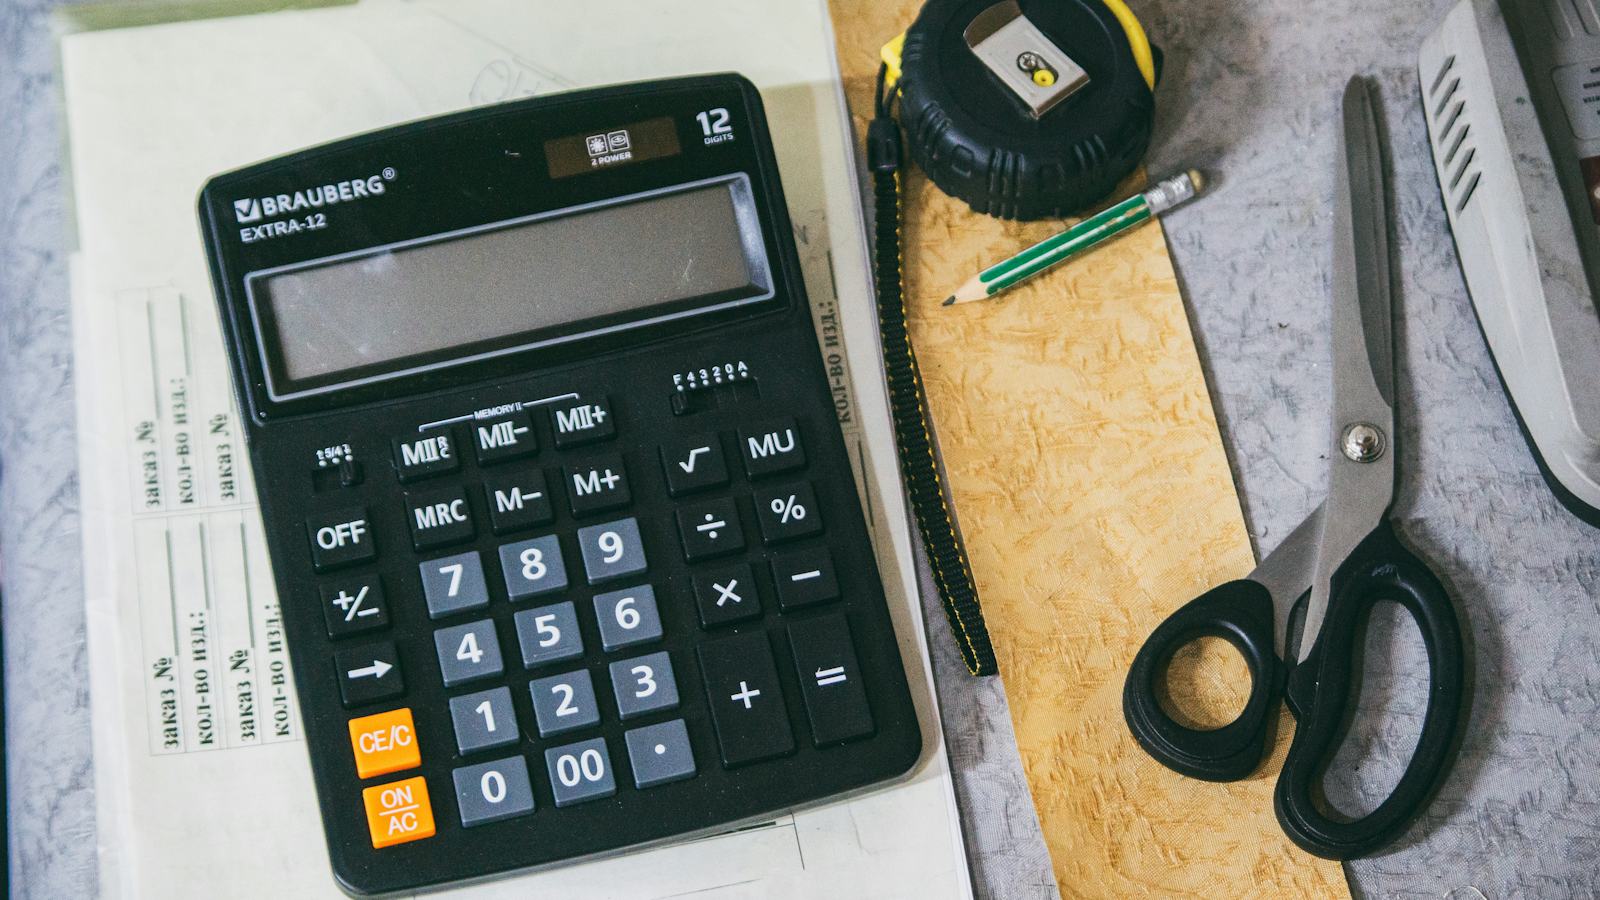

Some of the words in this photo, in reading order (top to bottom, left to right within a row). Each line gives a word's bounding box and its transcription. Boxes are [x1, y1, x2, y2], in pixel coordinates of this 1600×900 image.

[695, 107, 733, 136] 12
[703, 132, 734, 145] DIGITS
[591, 157, 598, 166] 2
[598, 151, 632, 165] POWER
[240, 213, 326, 243] EXTRA-12
[673, 374, 681, 385] F
[687, 371, 695, 381] 4
[699, 368, 708, 379] 3
[712, 366, 720, 377] 2
[738, 360, 748, 372] A
[208, 413, 230, 437] №
[473, 405, 513, 420] MEMORY
[135, 420, 155, 444] №
[748, 429, 795, 459] MU
[143, 450, 160, 508] заказ
[175, 432, 195, 504] кол-во
[216, 443, 236, 502] заказ
[573, 469, 620, 496] M+
[415, 499, 467, 530] MRC
[770, 495, 806, 523] %
[316, 519, 366, 550] OFF
[598, 531, 624, 564] 9
[520, 548, 547, 580] 8
[440, 564, 463, 597] 7
[615, 597, 641, 630] 6
[189, 612, 208, 662] изд.:
[535, 613, 561, 648] 5
[229, 649, 251, 674] №
[456, 632, 484, 663] 4
[153, 656, 175, 681] №
[631, 665, 657, 698] 3
[194, 669, 214, 746] кол-во
[237, 680, 256, 741] заказ
[269, 661, 290, 737] кол-во
[552, 683, 579, 717] 2
[161, 688, 179, 748] заказ
[475, 701, 496, 732] 1
[359, 725, 412, 754] CE/C
[556, 749, 604, 788] 00
[379, 785, 414, 810] ON
[480, 770, 507, 803] 0
[387, 811, 418, 836] AC
